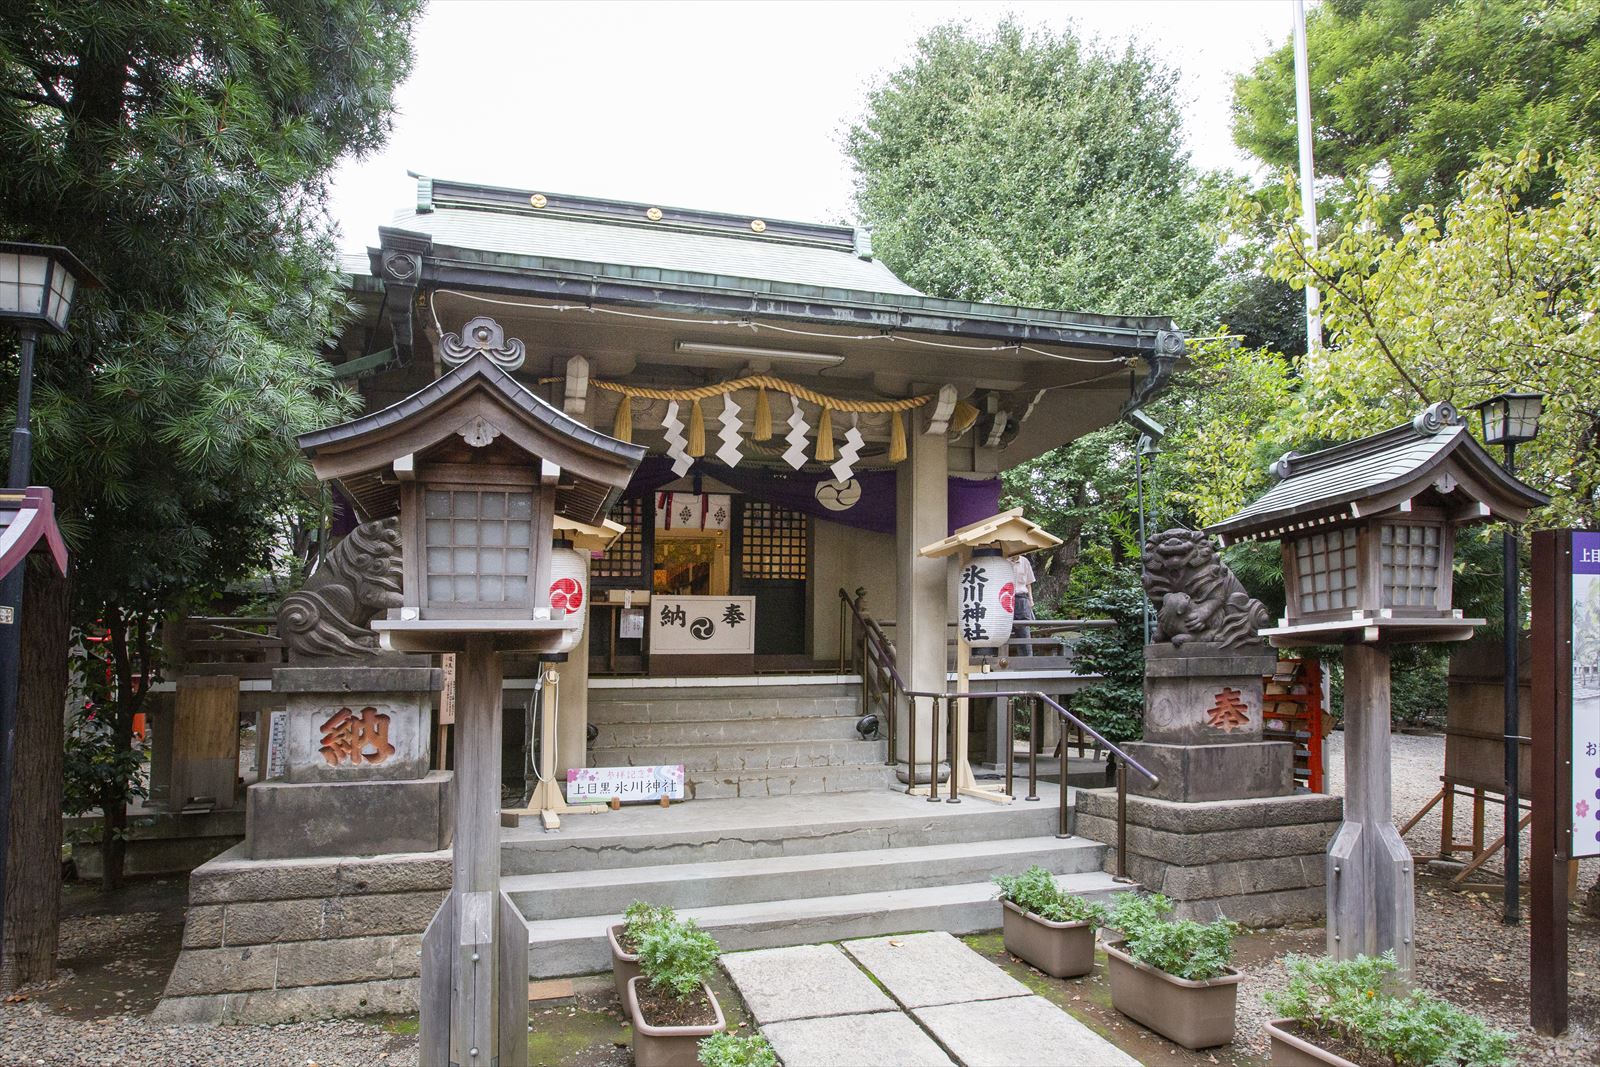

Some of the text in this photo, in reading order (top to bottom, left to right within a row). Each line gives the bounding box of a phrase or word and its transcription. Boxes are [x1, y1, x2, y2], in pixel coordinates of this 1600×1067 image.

[660, 604, 687, 628] 納
[721, 603, 746, 628] 奉
[961, 565, 989, 642] 氷川神社
[1207, 687, 1250, 734] 奉
[319, 706, 396, 767] 納
